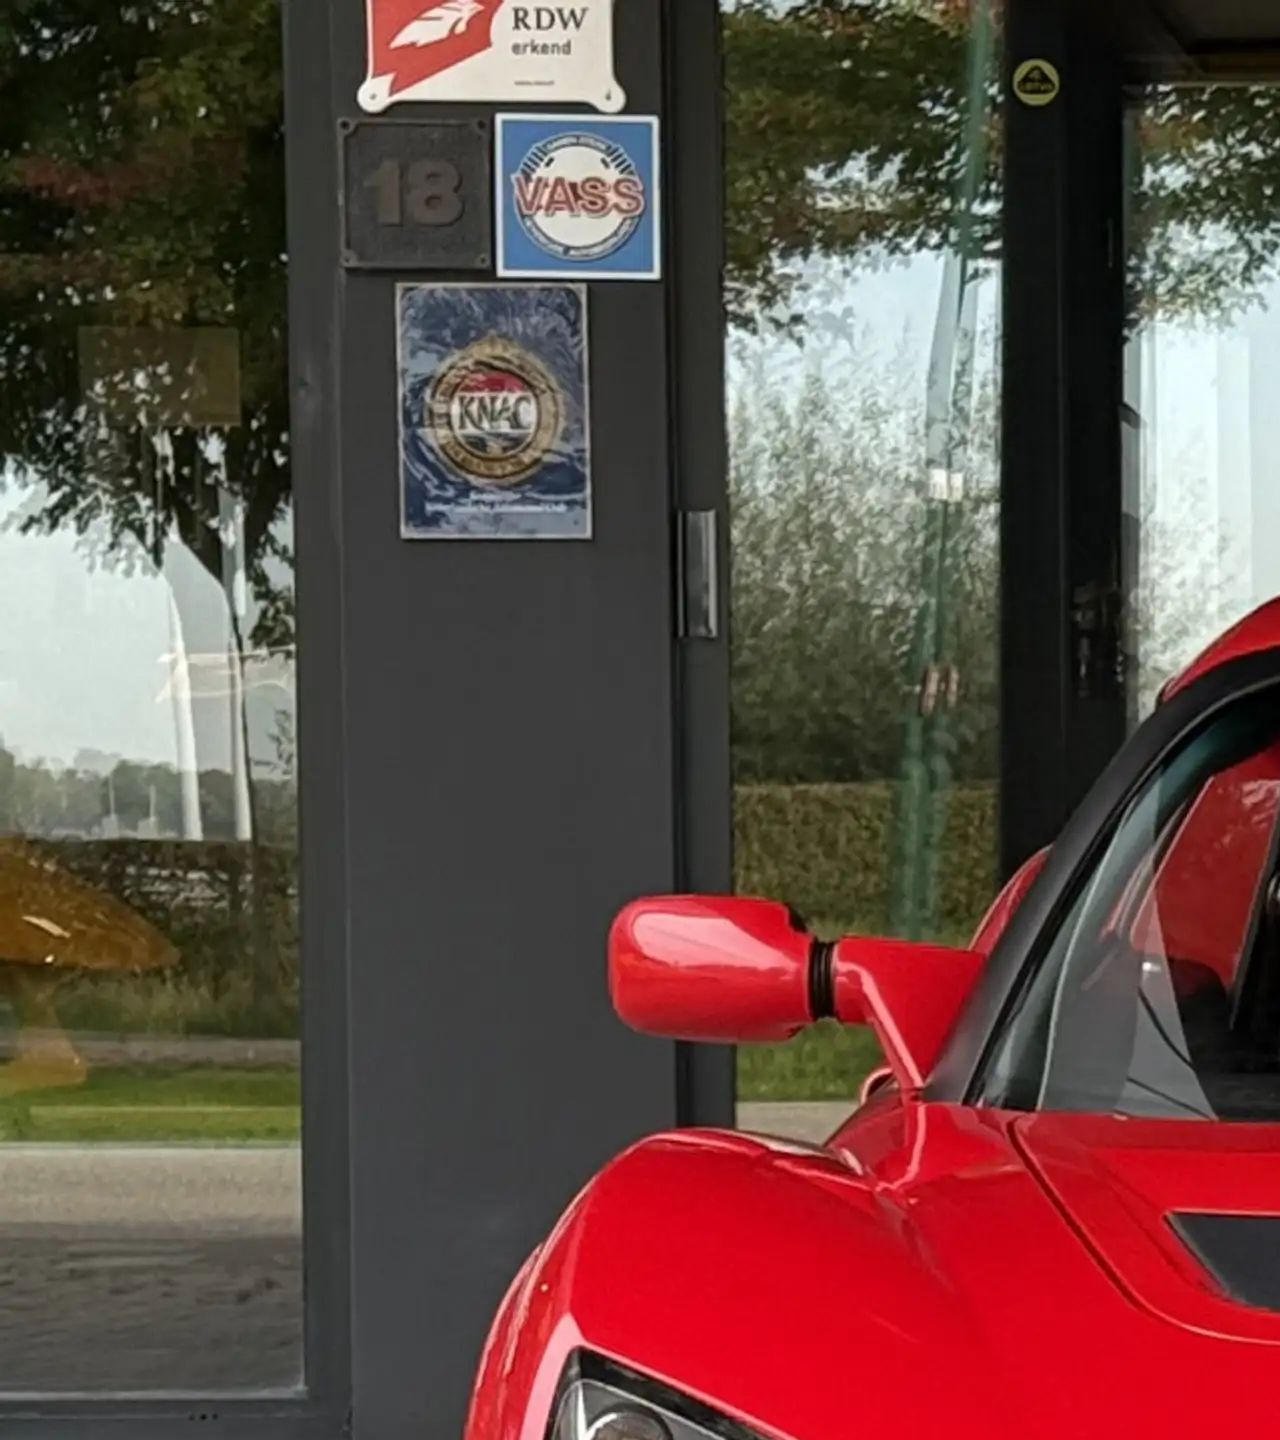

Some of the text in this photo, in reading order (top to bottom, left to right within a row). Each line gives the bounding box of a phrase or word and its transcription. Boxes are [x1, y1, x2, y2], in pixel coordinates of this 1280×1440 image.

[512, 6, 589, 31] RDW
[511, 38, 571, 56] erkend
[364, 160, 466, 228] 18
[513, 174, 645, 216] VASS
